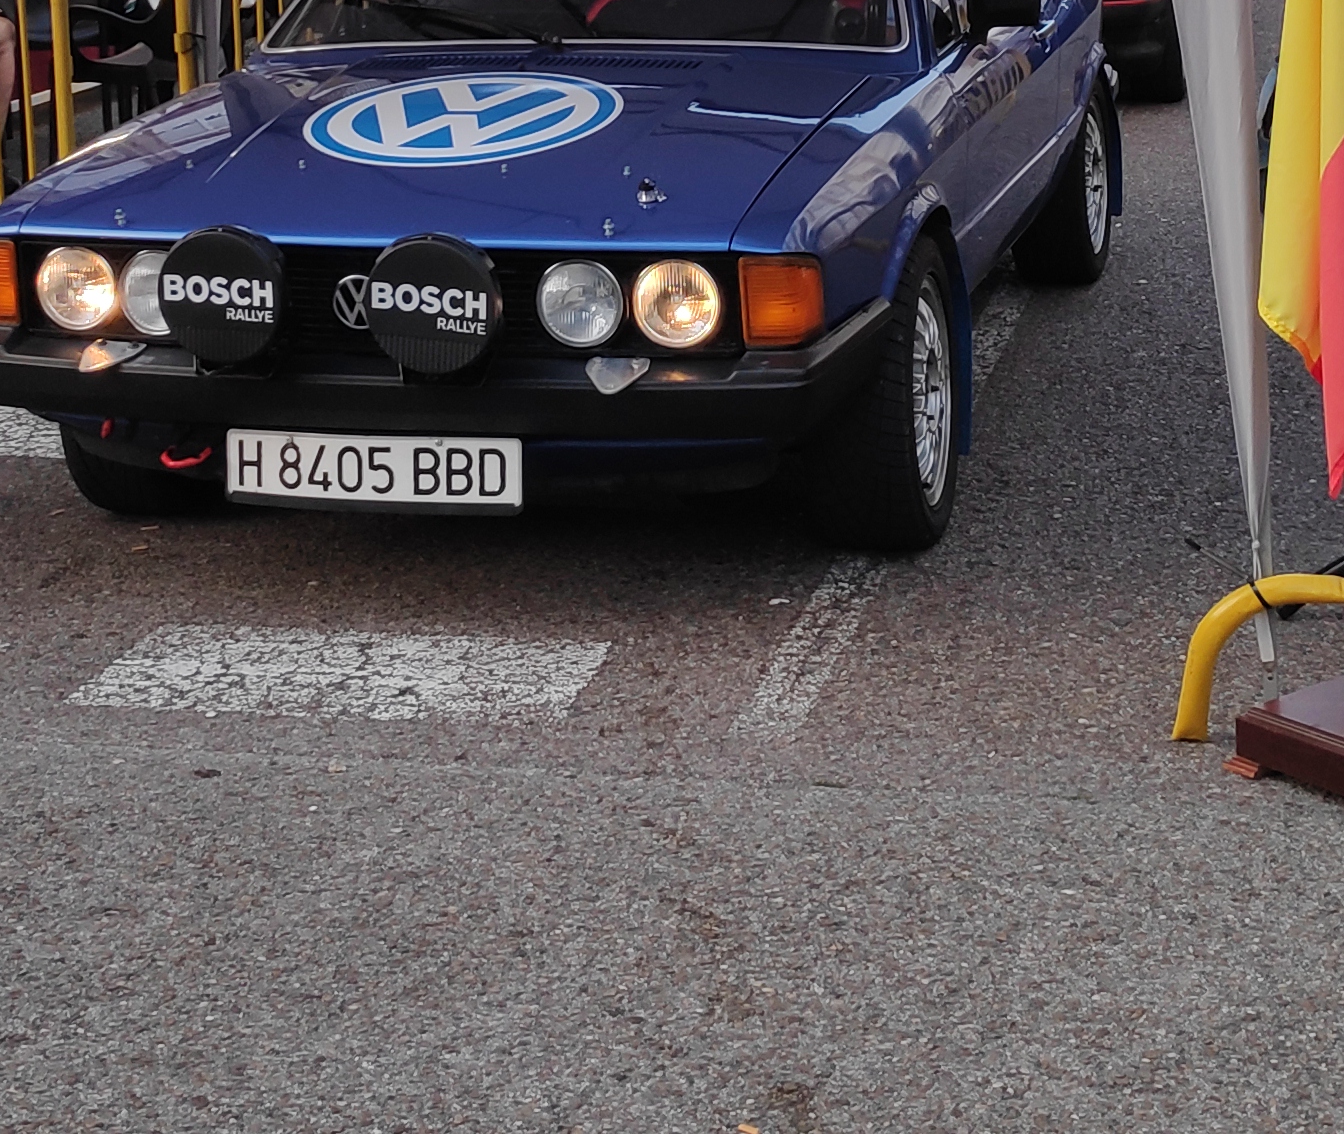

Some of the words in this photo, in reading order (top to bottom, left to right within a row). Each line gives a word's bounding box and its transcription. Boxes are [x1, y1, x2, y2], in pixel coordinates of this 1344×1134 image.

[162, 274, 274, 308] BOSCH
[370, 281, 488, 321] BOSCH
[226, 307, 274, 323] RALLYE
[436, 316, 487, 336] RALLYE
[237, 439, 263, 487] H
[278, 442, 394, 494] 8405
[413, 447, 506, 496] BBD
